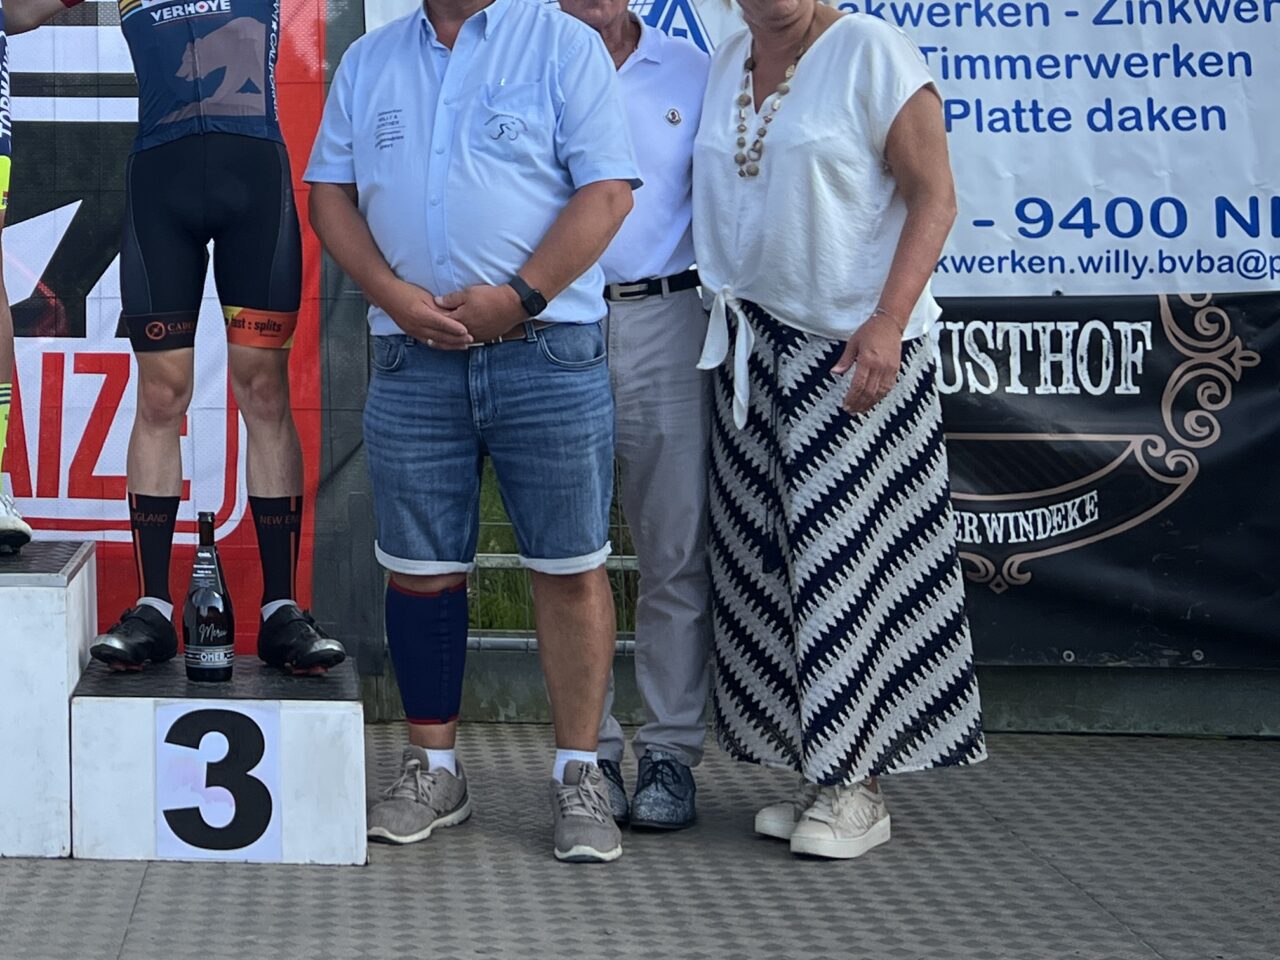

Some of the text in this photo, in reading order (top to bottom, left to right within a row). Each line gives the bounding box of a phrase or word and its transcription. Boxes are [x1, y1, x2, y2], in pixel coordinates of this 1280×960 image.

[919, 43, 1253, 80] Timmerwerken
[944, 97, 1227, 133] Platte daken
[1015, 196, 1188, 239] 9400
[254, 318, 282, 332] splits
[931, 319, 1153, 396] USTHOF
[134, 512, 168, 523] GLAND
[162, 708, 273, 851] 3
